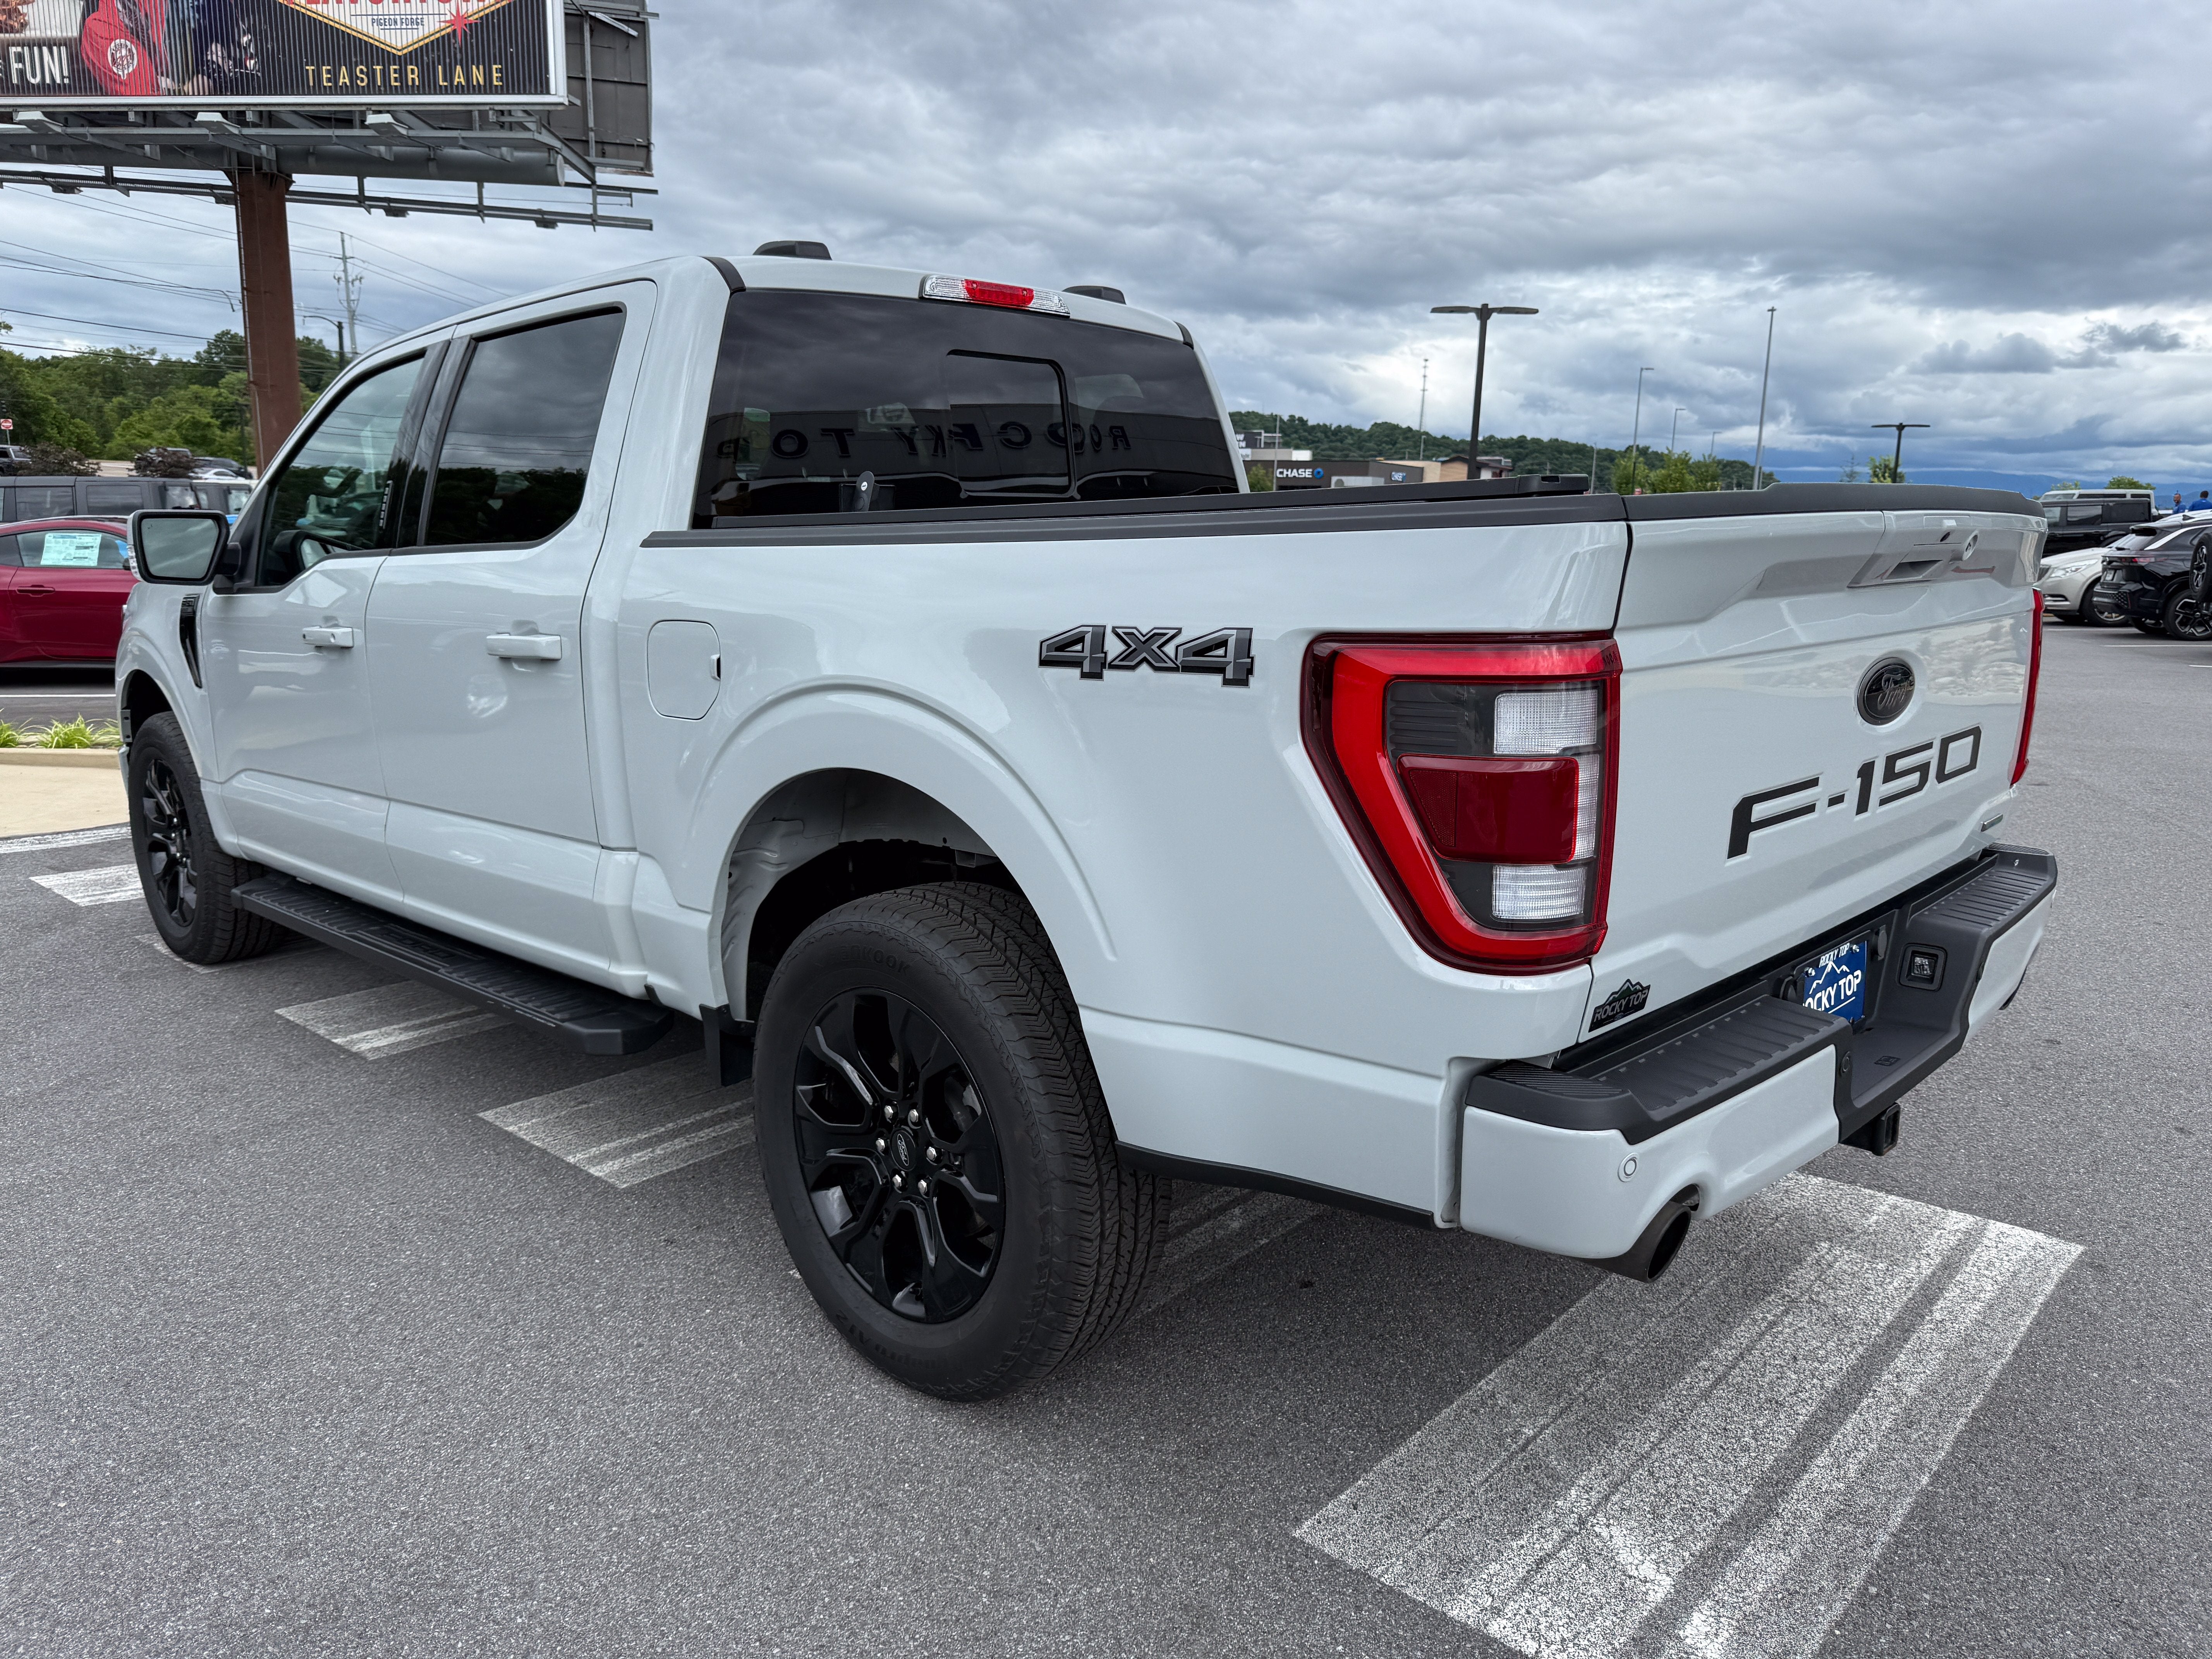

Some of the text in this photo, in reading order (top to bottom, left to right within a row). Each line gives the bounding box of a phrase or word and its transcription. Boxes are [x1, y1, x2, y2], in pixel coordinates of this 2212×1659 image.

[372, 17, 424, 26] PIGEON FORGE
[9, 46, 69, 84] FUN!
[306, 65, 503, 86] TEASTER LANE
[1276, 469, 1312, 477] CHASE
[1877, 673, 1908, 710] Ford
[1727, 725, 1982, 860] F-150
[1819, 943, 1850, 968] ROCKY TOP
[1594, 989, 1648, 1022] ROCKY TOP
[1803, 970, 1862, 1011] OCKY TOP
